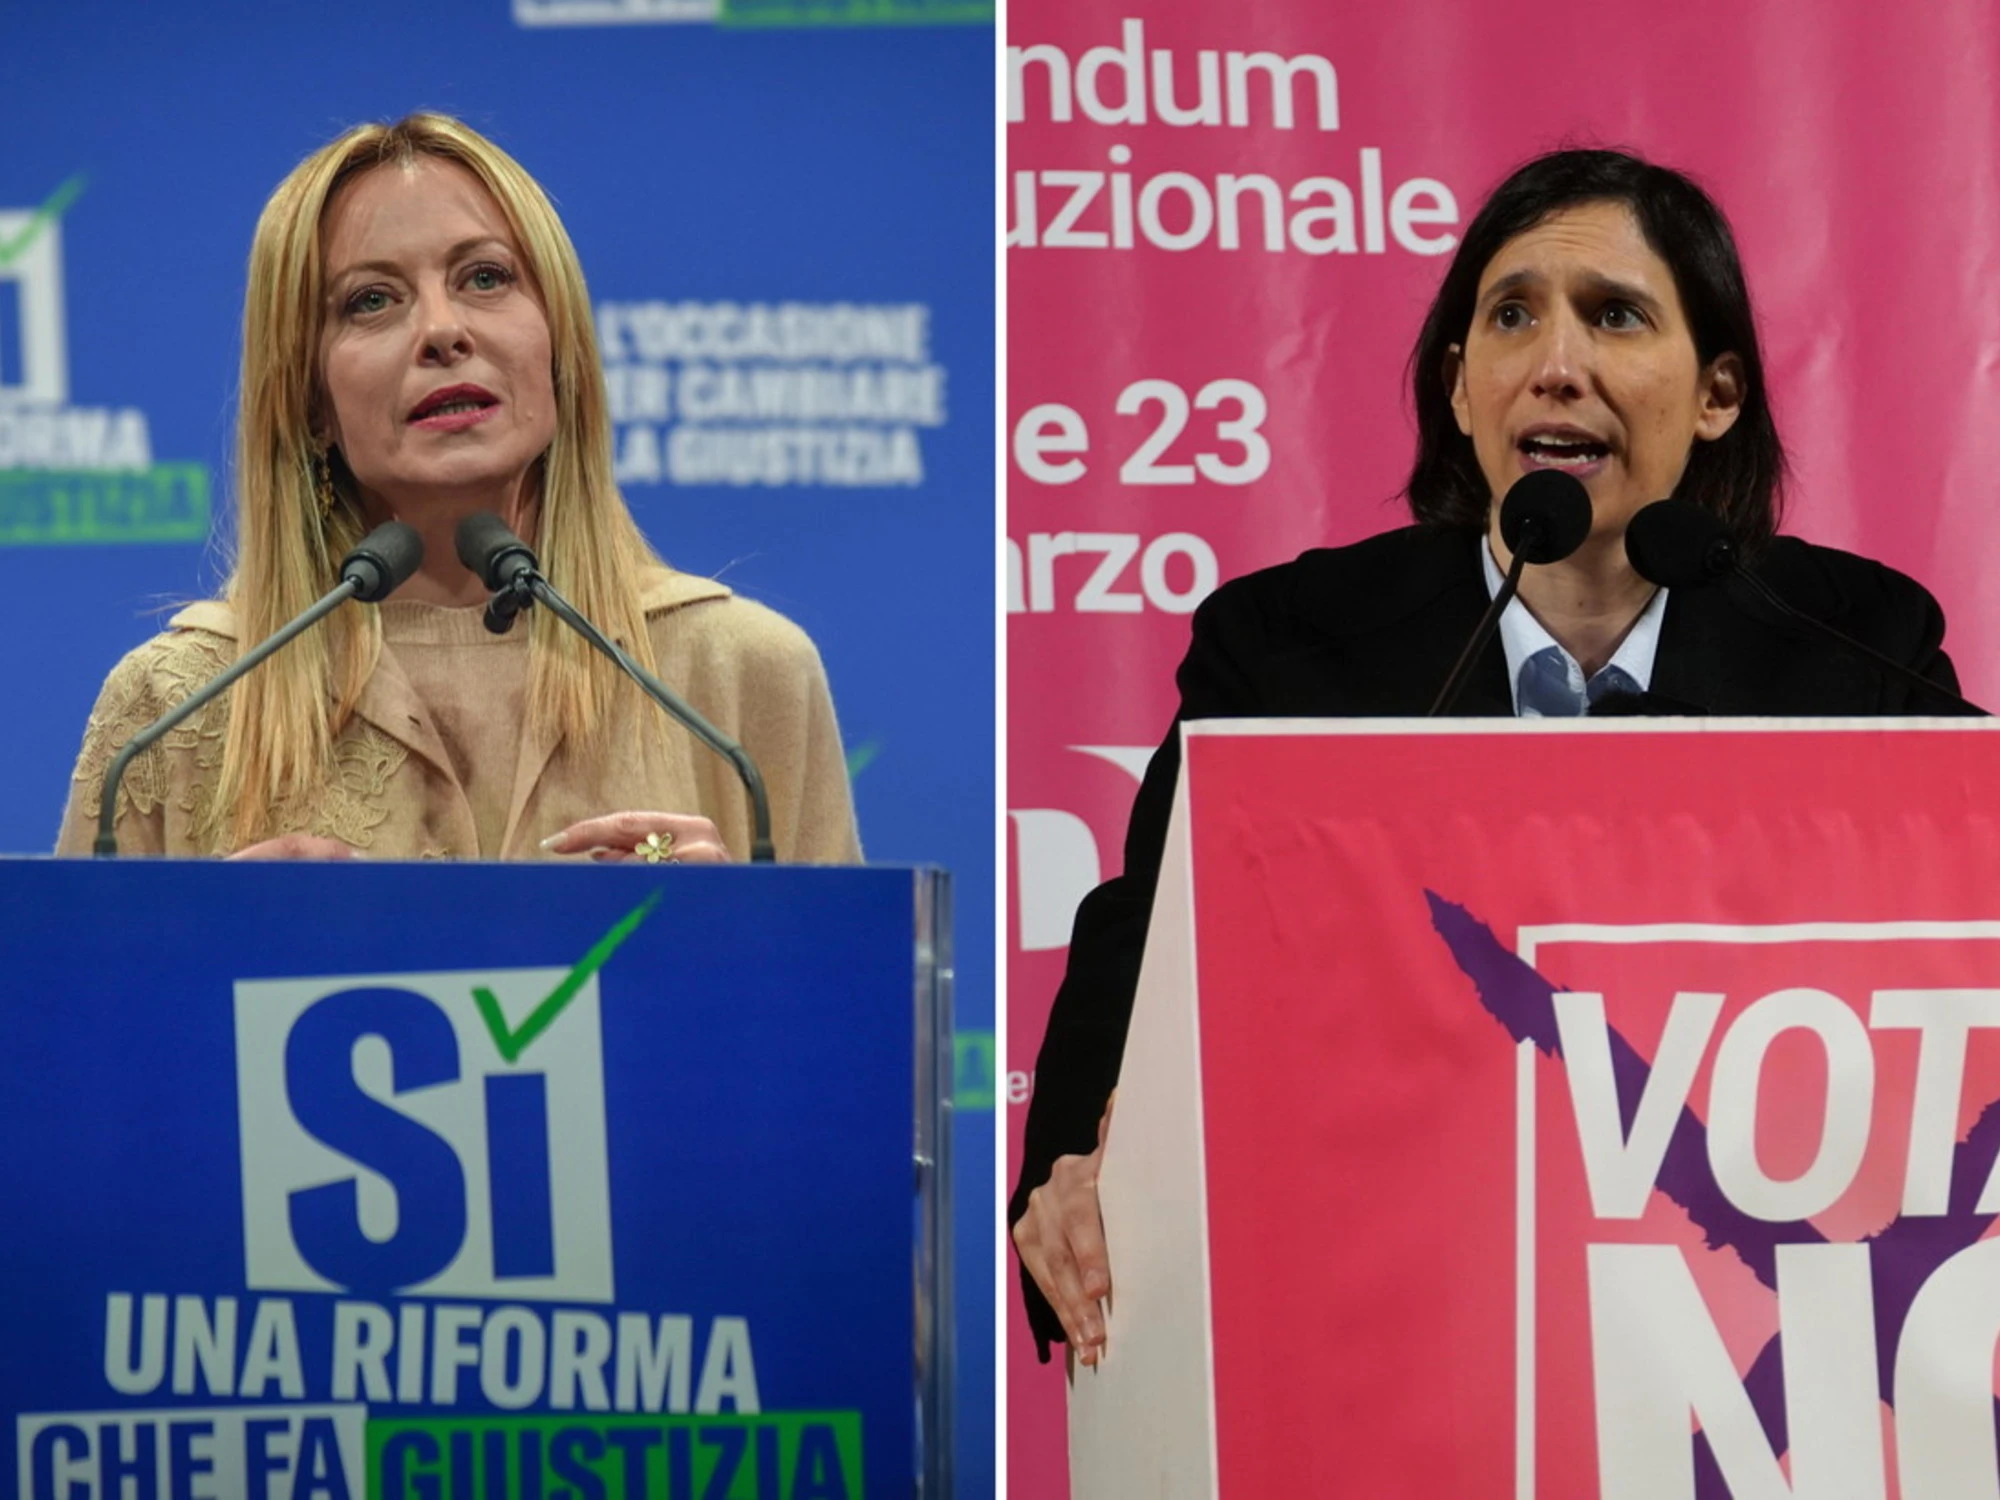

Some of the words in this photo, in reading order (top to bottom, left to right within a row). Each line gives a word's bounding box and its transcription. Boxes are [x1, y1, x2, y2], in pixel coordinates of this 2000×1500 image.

[1006, 18, 1340, 131] ndum
[606, 366, 670, 424] ER
[1013, 404, 1089, 485] e
[1115, 379, 1271, 486] 23
[1006, 531, 1219, 614] rzo
[1552, 987, 2000, 1222] VOT
[104, 1292, 305, 1399] UNA
[331, 1300, 761, 1415] RIFORMA
[31, 1420, 215, 1500] CHE
[244, 1417, 354, 1500] FA
[380, 1423, 852, 1500] GIUSTIZIA
